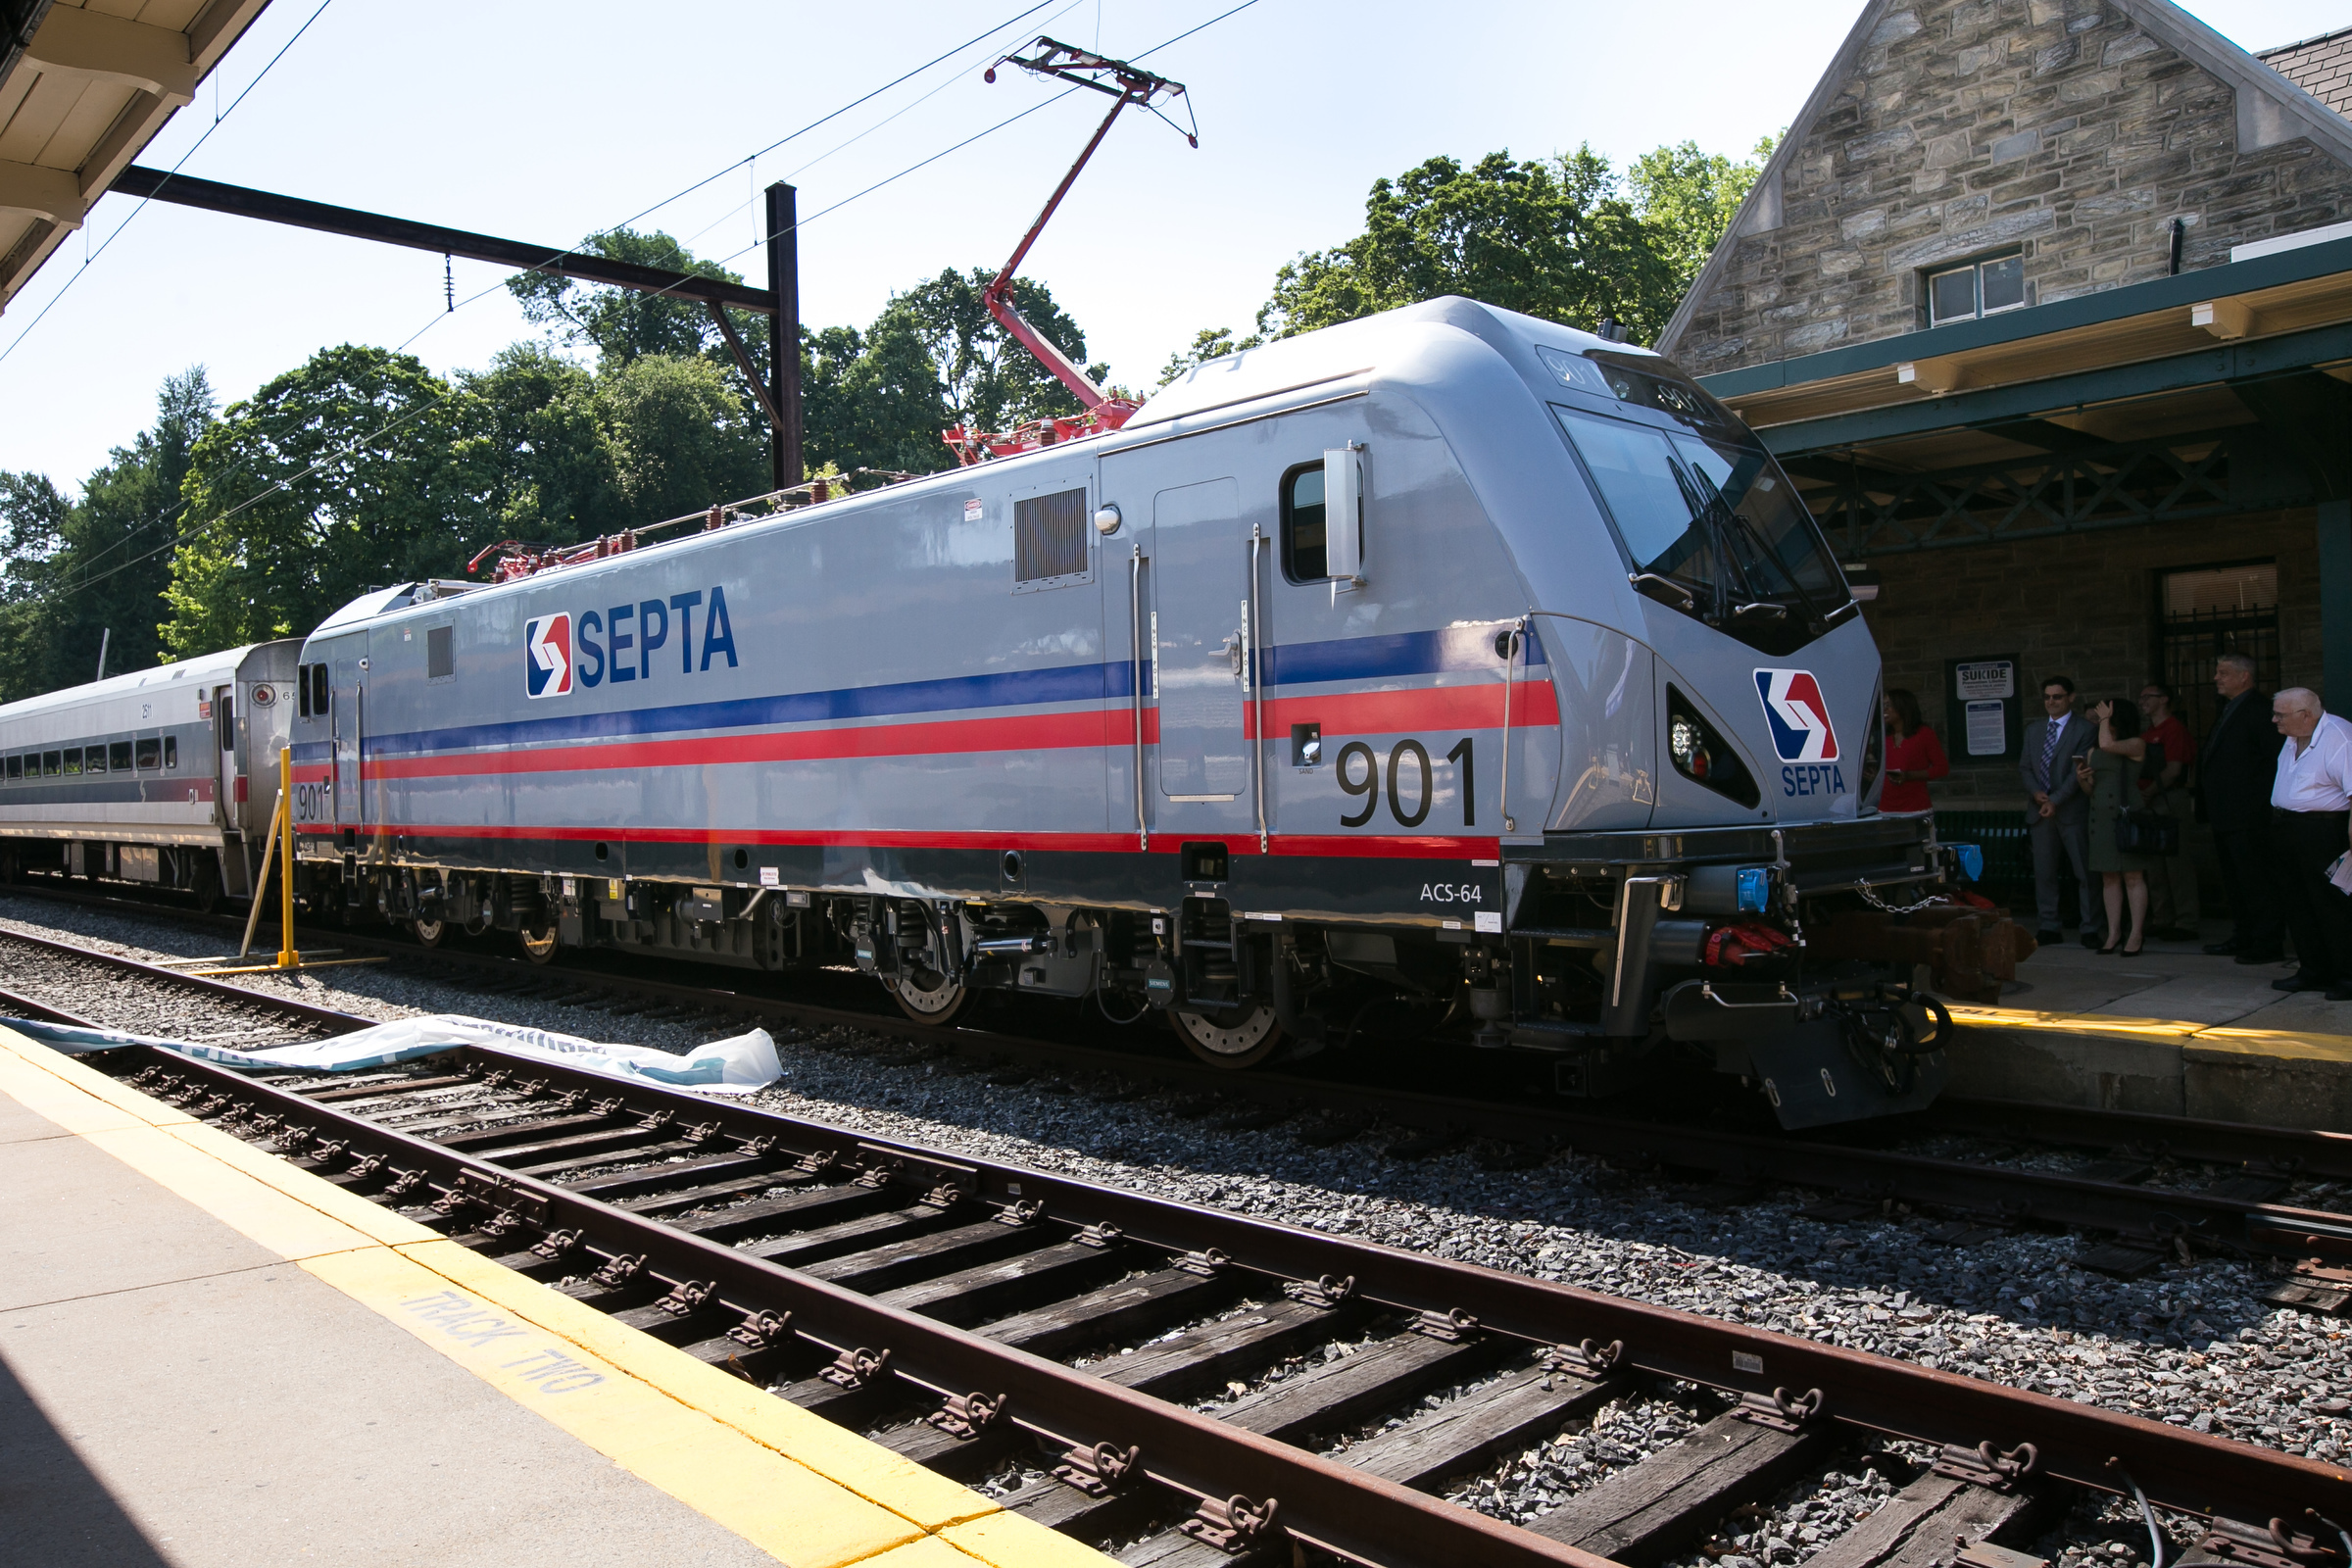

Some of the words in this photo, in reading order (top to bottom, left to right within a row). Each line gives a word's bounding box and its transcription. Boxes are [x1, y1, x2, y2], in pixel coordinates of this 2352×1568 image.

[1545, 354, 1600, 389] 901
[1657, 384, 1707, 416] 901
[577, 585, 739, 688] SEPTA
[1962, 669, 2007, 681] SUICIDE
[142, 704, 152, 719] 2511
[1335, 737, 1476, 828] 901
[1782, 764, 1846, 797] SEPTA
[299, 784, 323, 821] 901
[1420, 883, 1482, 904] ACS-64
[400, 1291, 528, 1348] TRACK
[500, 1348, 606, 1395] TWO
